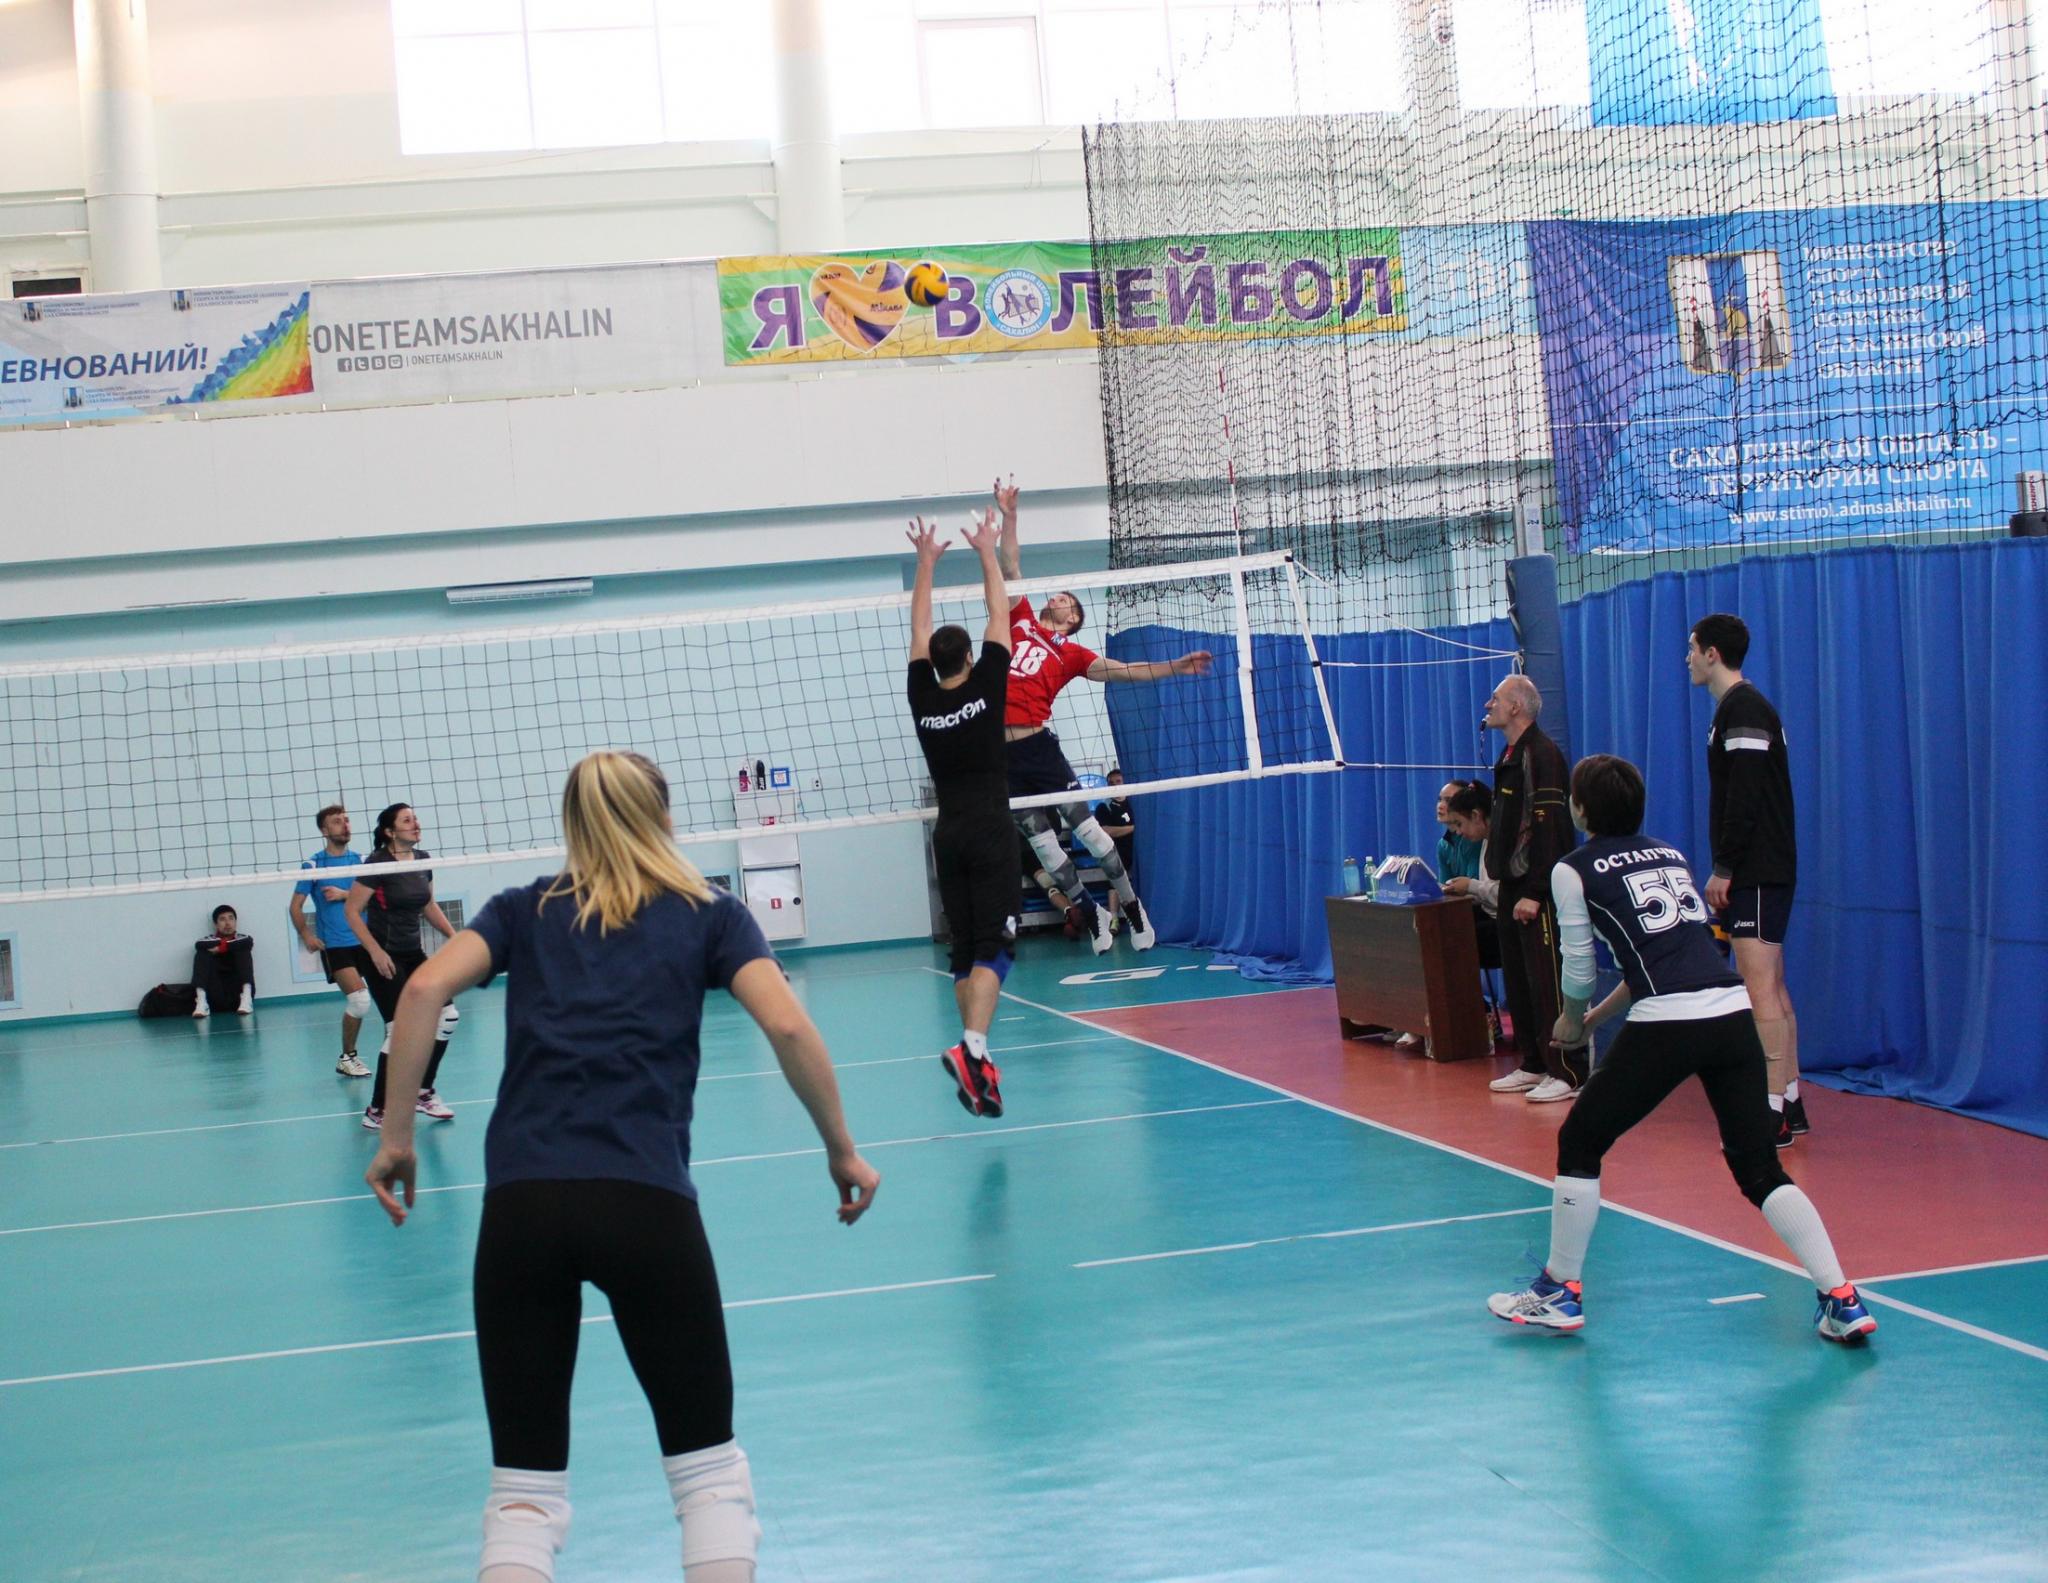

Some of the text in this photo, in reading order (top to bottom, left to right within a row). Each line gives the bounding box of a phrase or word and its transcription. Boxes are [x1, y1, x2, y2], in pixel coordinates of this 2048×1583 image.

[752, 285, 804, 348] Я
[1, 342, 208, 384] ЕВНОВАНИЙ!
[1887, 458, 1988, 484] СПОРТА
[1010, 640, 1048, 675] 18
[1622, 866, 1708, 934] 55
